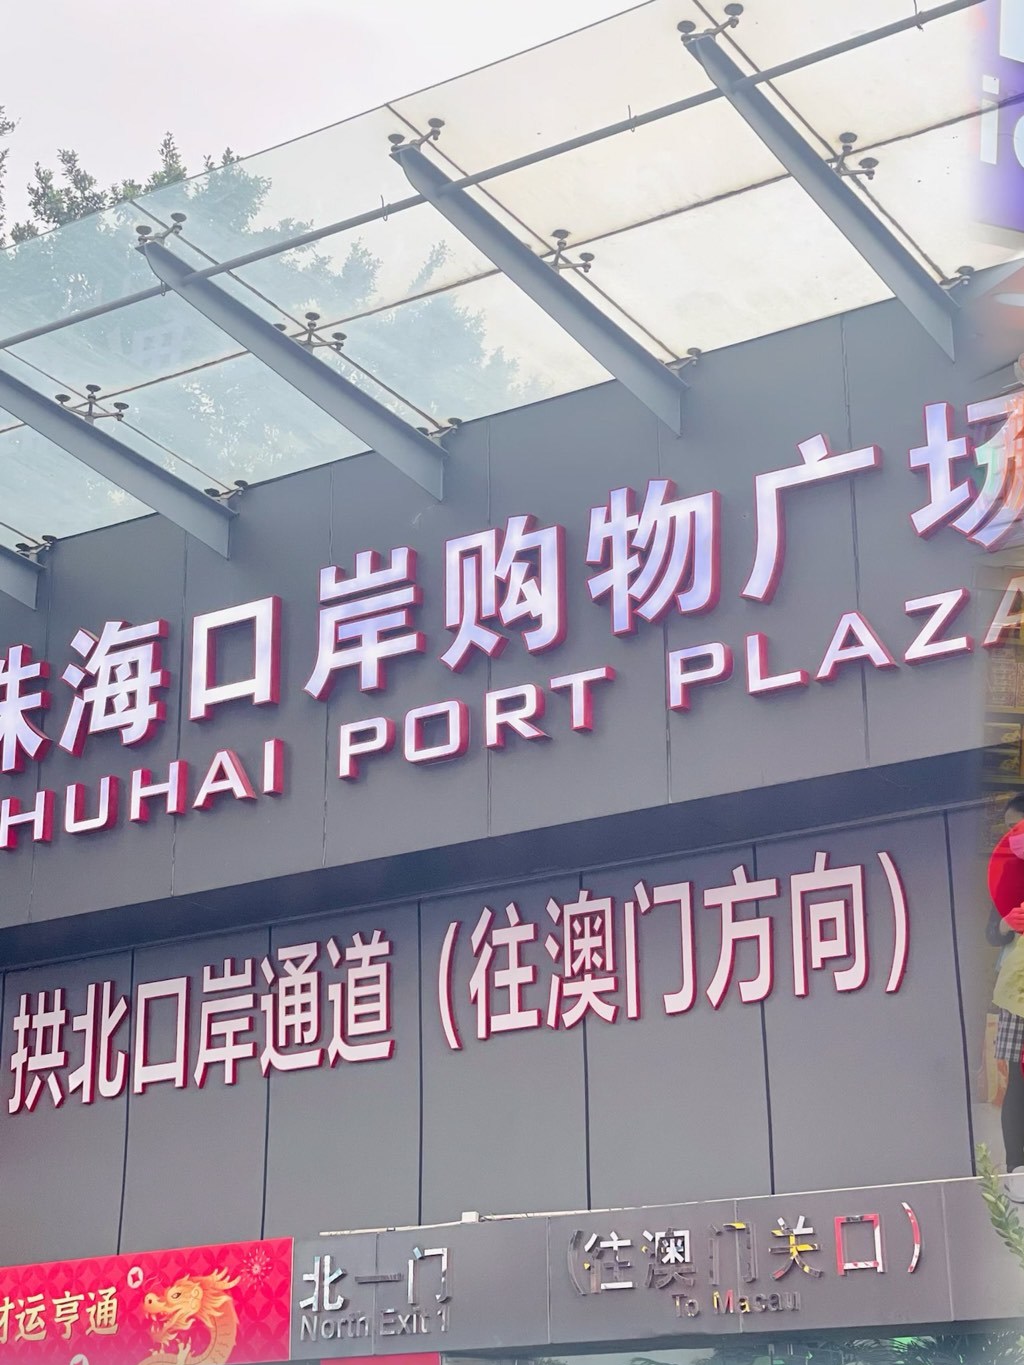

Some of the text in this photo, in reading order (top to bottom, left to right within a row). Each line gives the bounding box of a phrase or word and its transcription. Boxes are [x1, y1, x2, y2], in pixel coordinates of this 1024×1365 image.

[0, 738, 284, 850] HUHAI
[339, 666, 616, 779] PORT
[8, 929, 396, 1114] 拱北口岸通道
[300, 1247, 454, 1312] 北一门
[671, 1290, 801, 1318] To Macau
[300, 1312, 370, 1341] North
[380, 1308, 430, 1337] Exit
